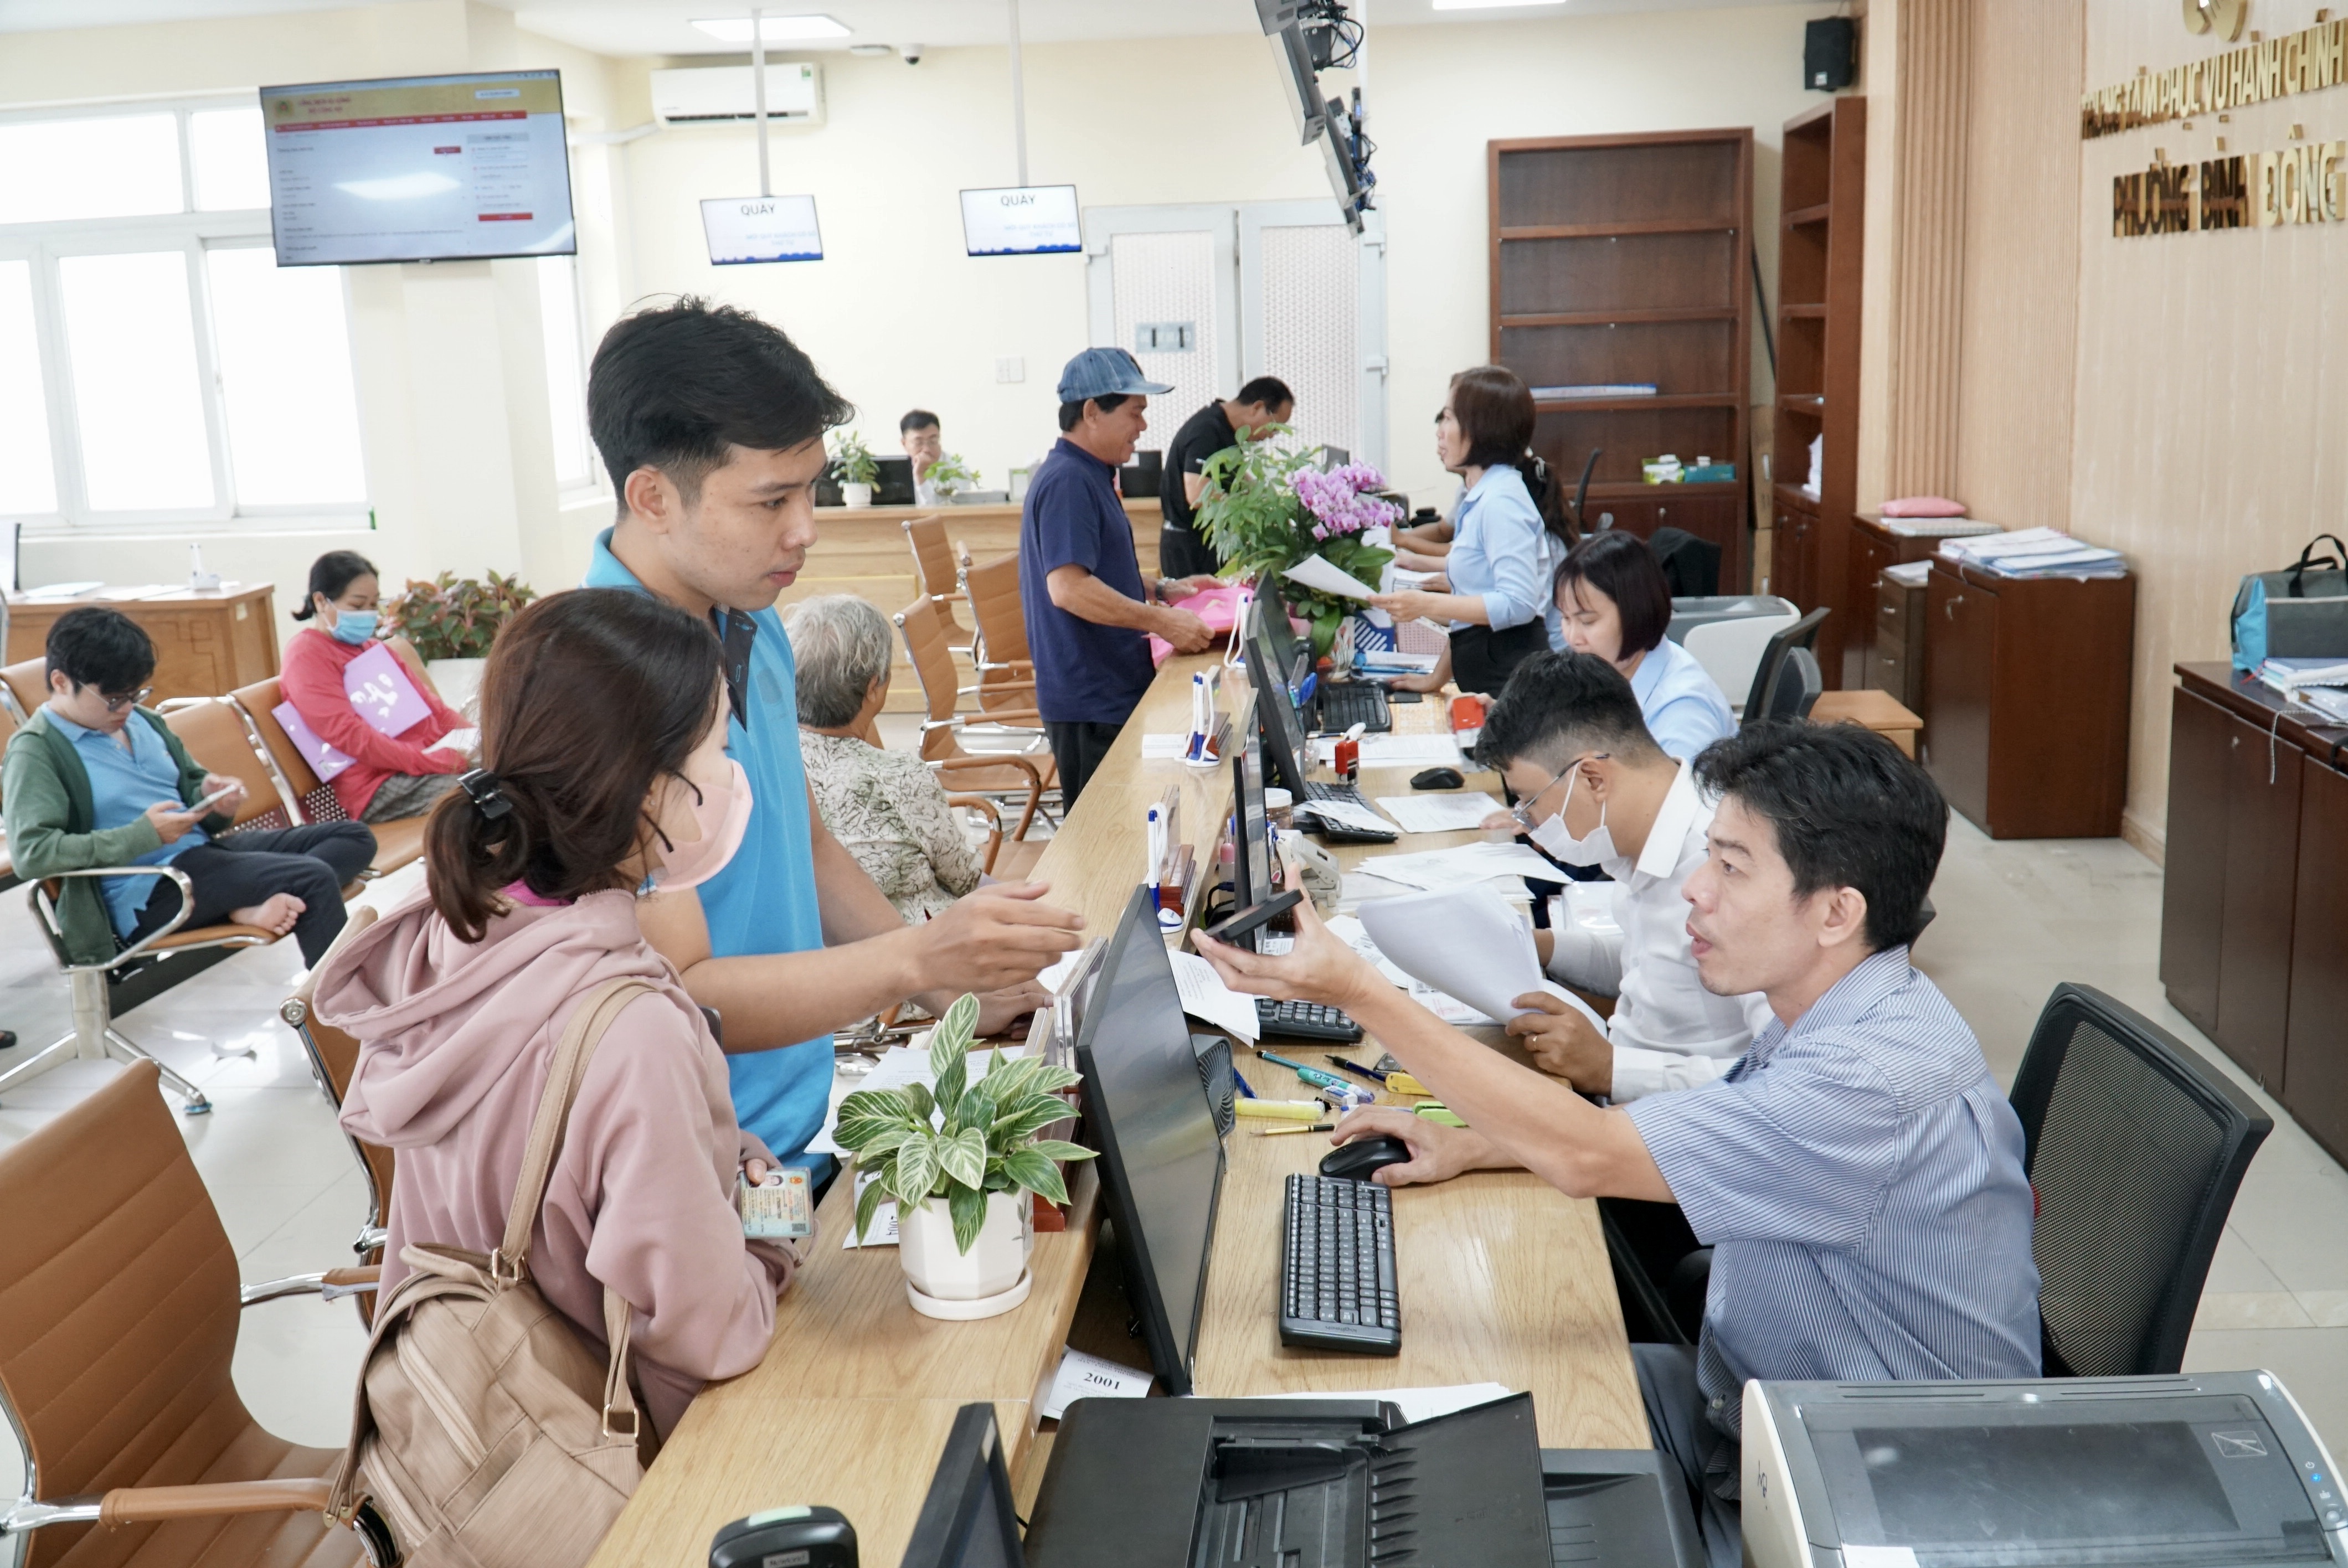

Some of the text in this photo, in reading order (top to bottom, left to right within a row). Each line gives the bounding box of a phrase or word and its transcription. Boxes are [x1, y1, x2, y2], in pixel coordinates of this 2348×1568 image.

[2159, 60, 2203, 130] PHỤC
[2203, 53, 2230, 123] VỤ
[2229, 29, 2283, 109] HÀNH
[2285, 8, 2346, 96] CHÍNH
[2201, 136, 2259, 230] BÌNH
[2262, 123, 2347, 227] ĐÔNG
[1084, 1372, 1120, 1390] 2001
